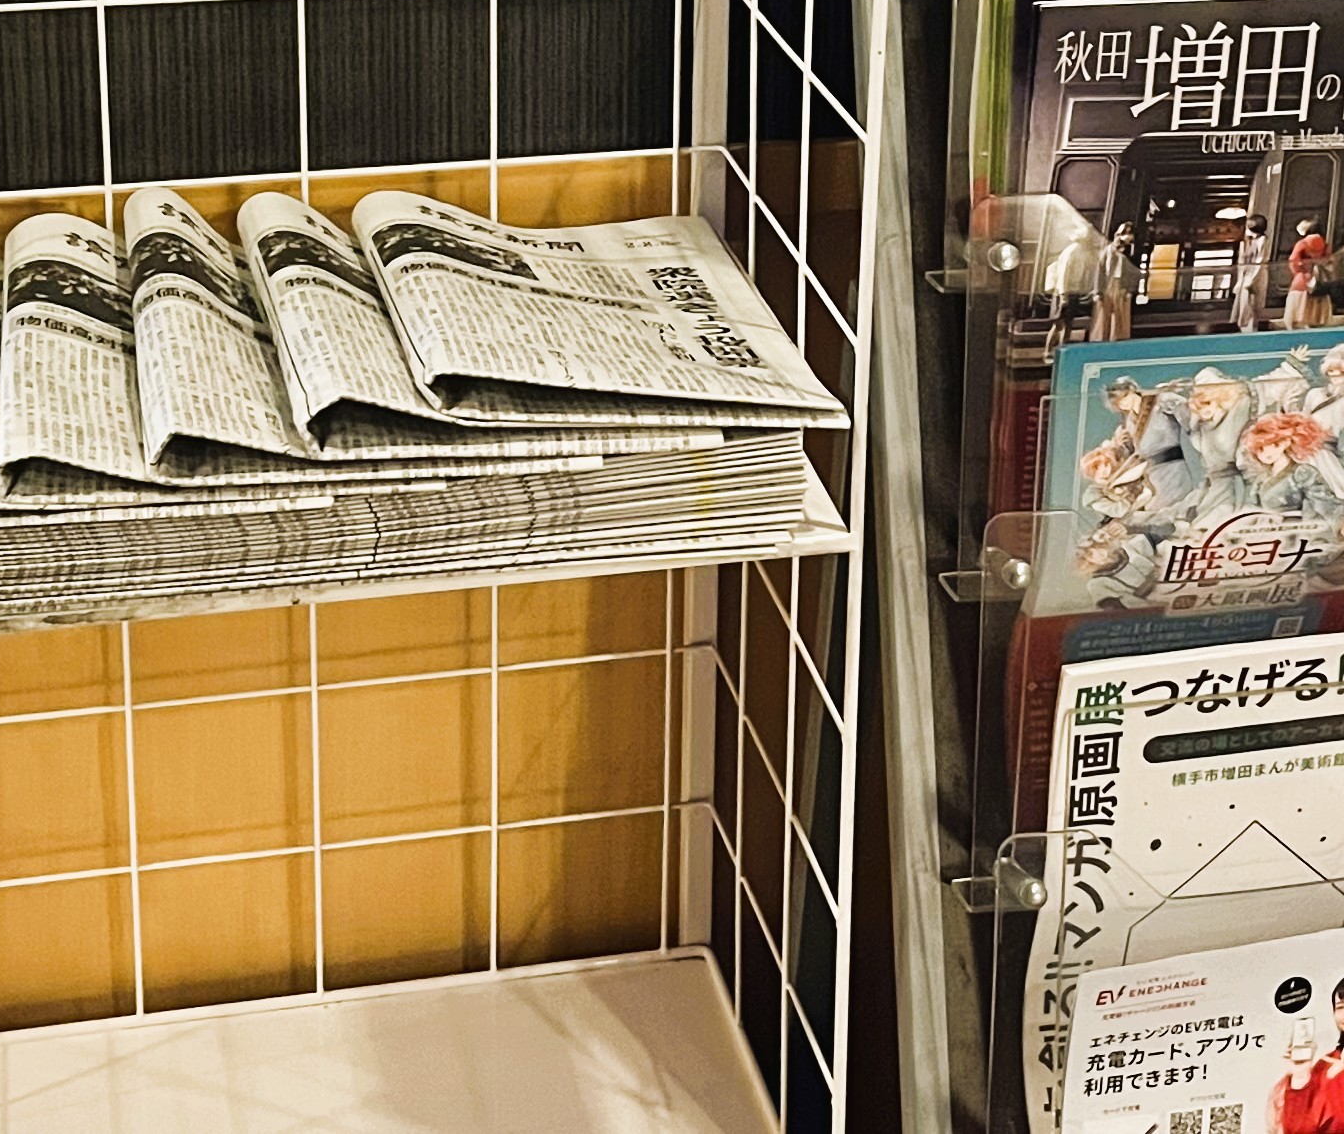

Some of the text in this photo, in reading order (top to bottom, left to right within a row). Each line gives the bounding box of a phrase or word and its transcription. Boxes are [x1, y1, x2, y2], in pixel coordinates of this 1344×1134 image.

[1201, 133, 1276, 154] UCHIGURA
[1163, 538, 1323, 584] 暁のヨナ
[1095, 984, 1127, 1007] EV
[1089, 1014, 1244, 1048] エネチェンジのEV充電は
[1085, 1033, 1266, 1074] 充電カード、アプリで
[1083, 1063, 1209, 1098] 利用できます!
